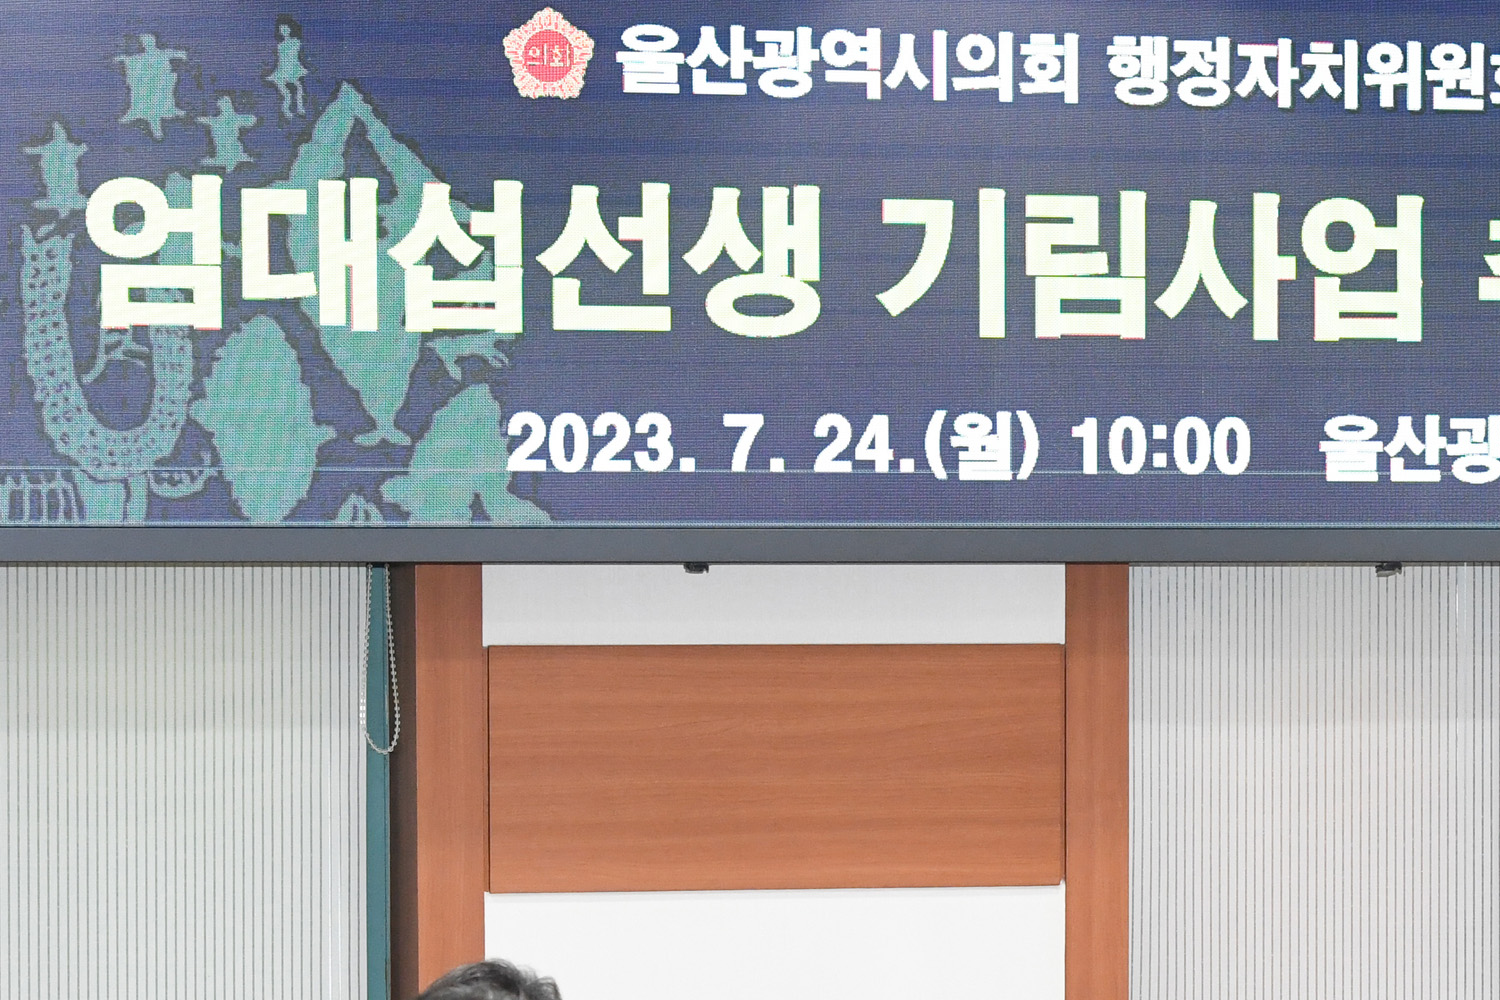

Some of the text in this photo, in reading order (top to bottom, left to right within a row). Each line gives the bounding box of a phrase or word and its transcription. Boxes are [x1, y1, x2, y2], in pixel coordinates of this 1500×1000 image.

[526, 42, 571, 68] 의회
[615, 24, 1081, 104] 울산광역시의회
[84, 174, 822, 339] 엄대섭선생
[876, 188, 1424, 343] 기림사업
[506, 412, 697, 474] 2023.
[723, 413, 786, 474] 7.
[813, 410, 1041, 483] 24.(월)
[1072, 416, 1253, 477] 10:00
